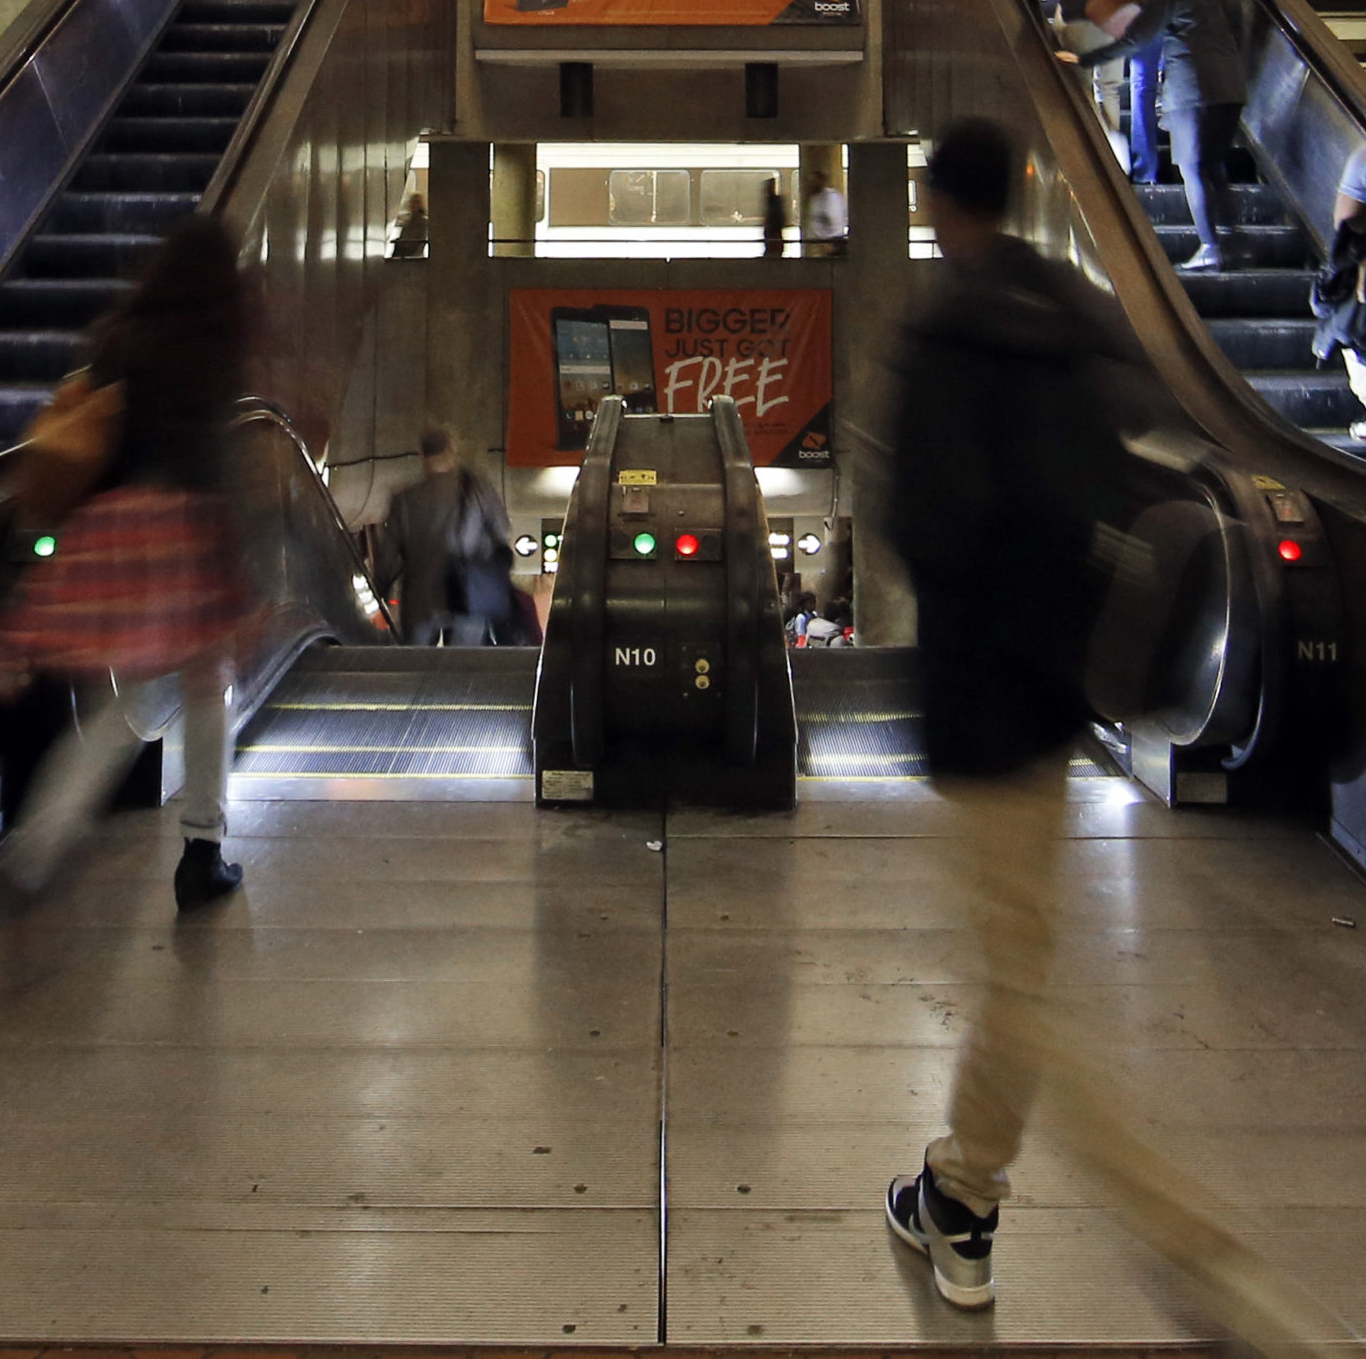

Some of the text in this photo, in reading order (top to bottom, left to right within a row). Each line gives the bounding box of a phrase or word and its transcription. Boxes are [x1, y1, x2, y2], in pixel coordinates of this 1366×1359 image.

[814, 1, 851, 12] boost
[664, 308, 791, 334] BIGGER
[664, 339, 791, 358] JUST GOT
[663, 356, 790, 417] FREE
[615, 647, 656, 667] N10
[1297, 640, 1339, 662] N11
